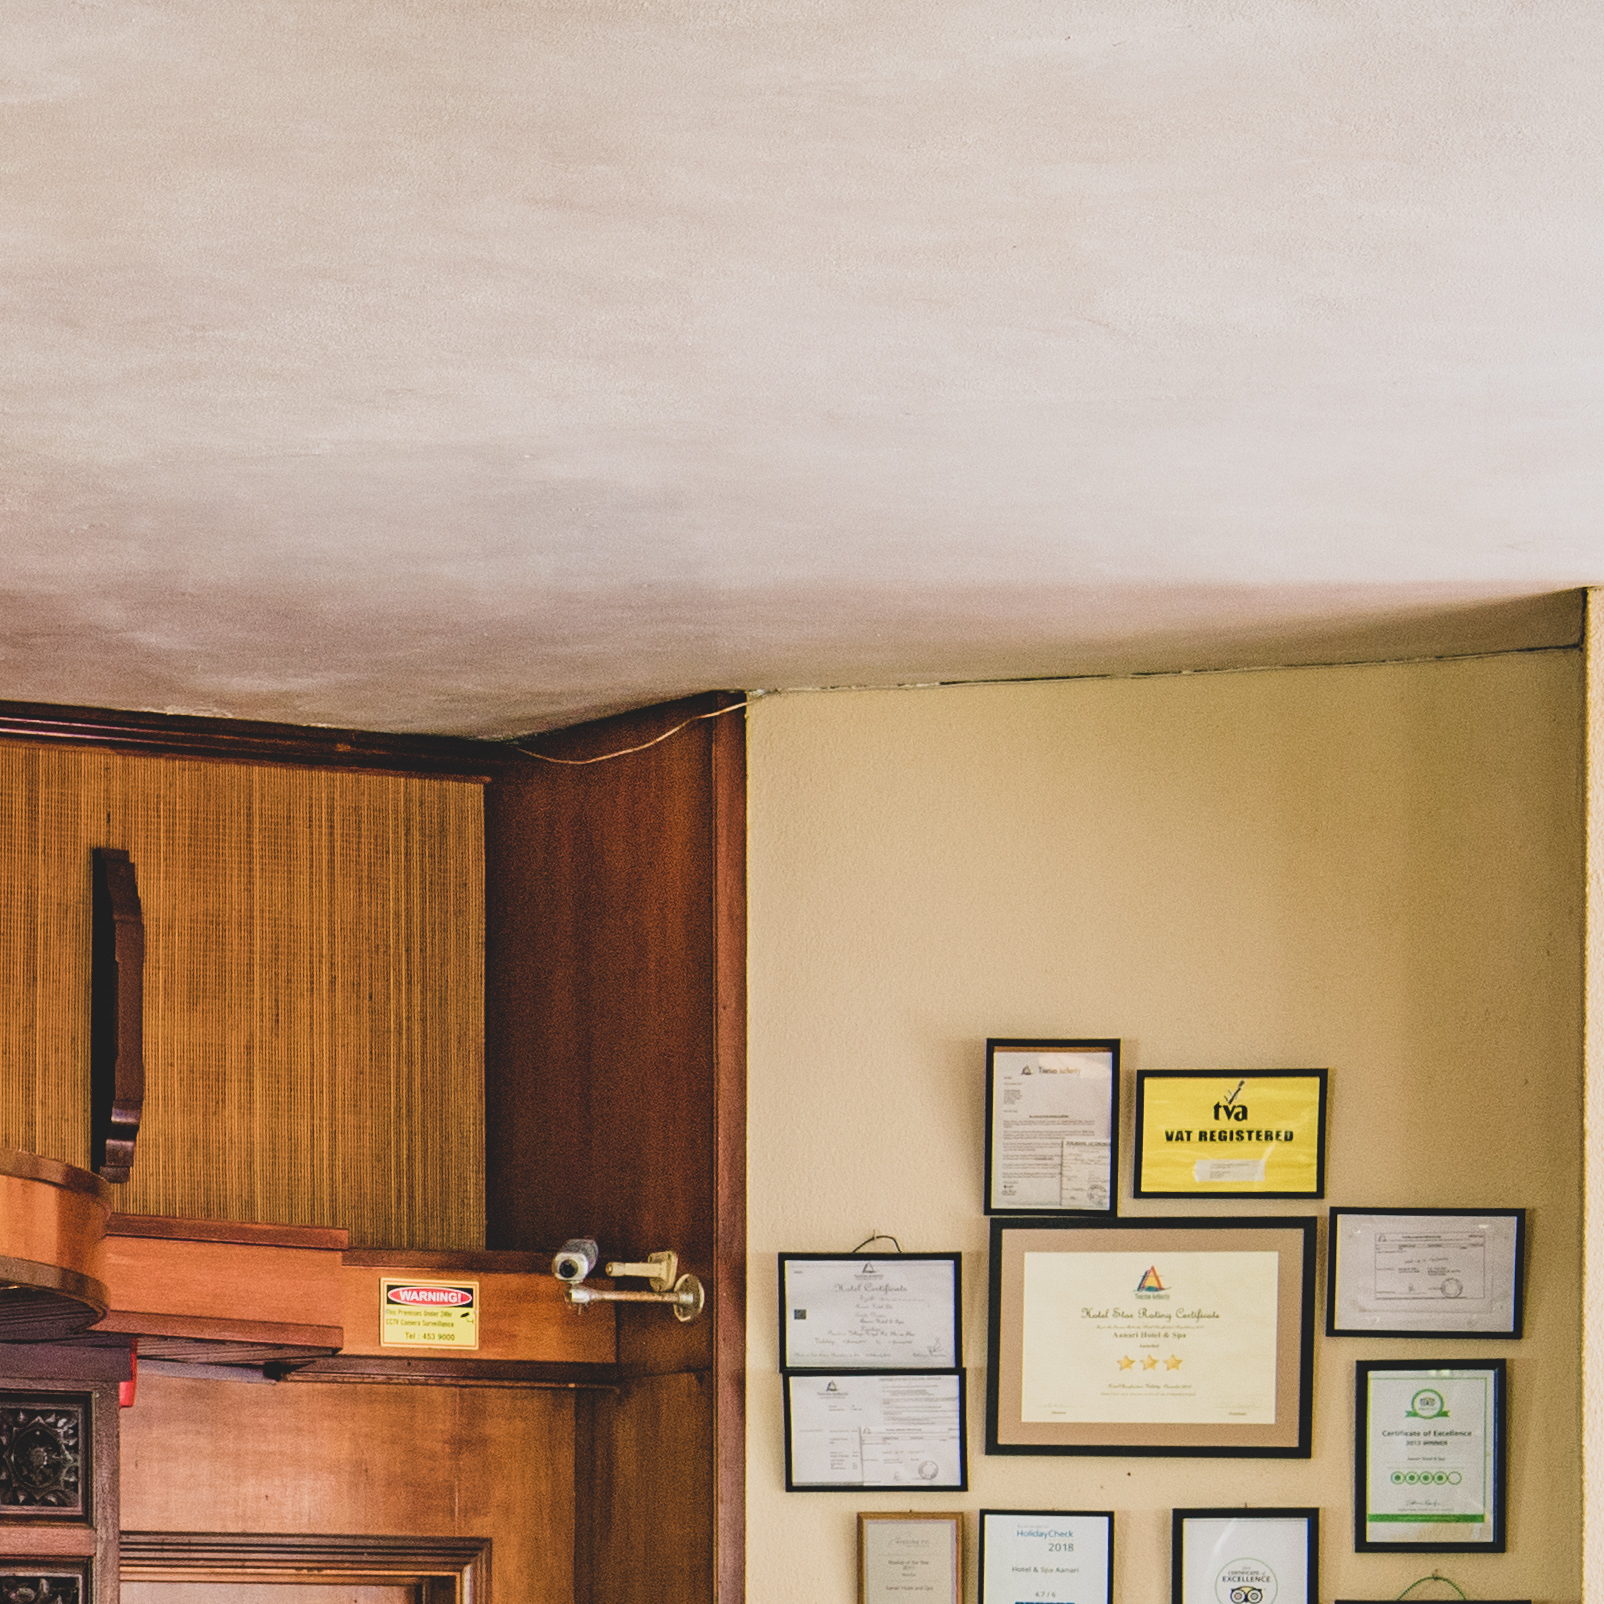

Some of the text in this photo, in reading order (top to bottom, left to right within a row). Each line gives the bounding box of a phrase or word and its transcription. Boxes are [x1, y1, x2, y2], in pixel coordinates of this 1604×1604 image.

[1213, 1101, 1248, 1122] tva
[1165, 1130, 1294, 1142] VAT REGISTERED
[399, 1290, 462, 1303] WARNING!
[1080, 1307, 1220, 1323] Hotel Star Rating Certificate
[405, 1332, 416, 1340] Tel
[437, 1333, 456, 1341] 9000
[1381, 1429, 1473, 1437] Certificate of Excellence
[1016, 1529, 1074, 1539] HolidayCheck
[1048, 1543, 1074, 1552] 2018
